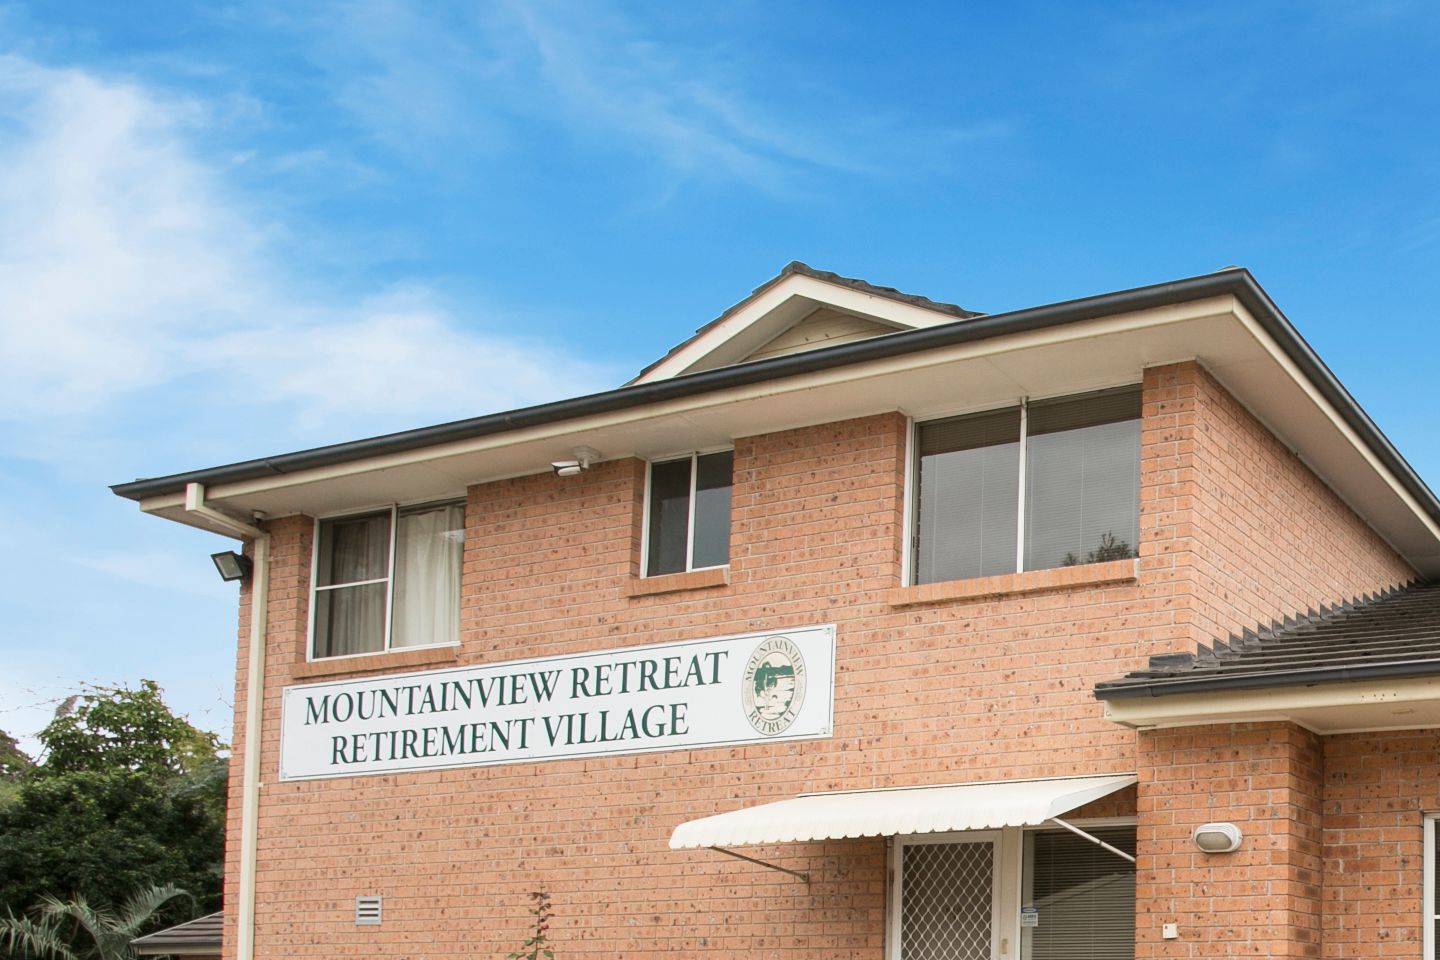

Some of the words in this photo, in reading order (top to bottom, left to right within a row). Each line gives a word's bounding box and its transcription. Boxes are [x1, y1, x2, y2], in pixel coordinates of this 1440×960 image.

[304, 669, 562, 726] MOUNTAINVIEW
[570, 649, 729, 698] RETREAT
[330, 717, 535, 766] RETIREMENT
[542, 702, 690, 748] VILLAGE
[748, 707, 796, 733] RETREAT
